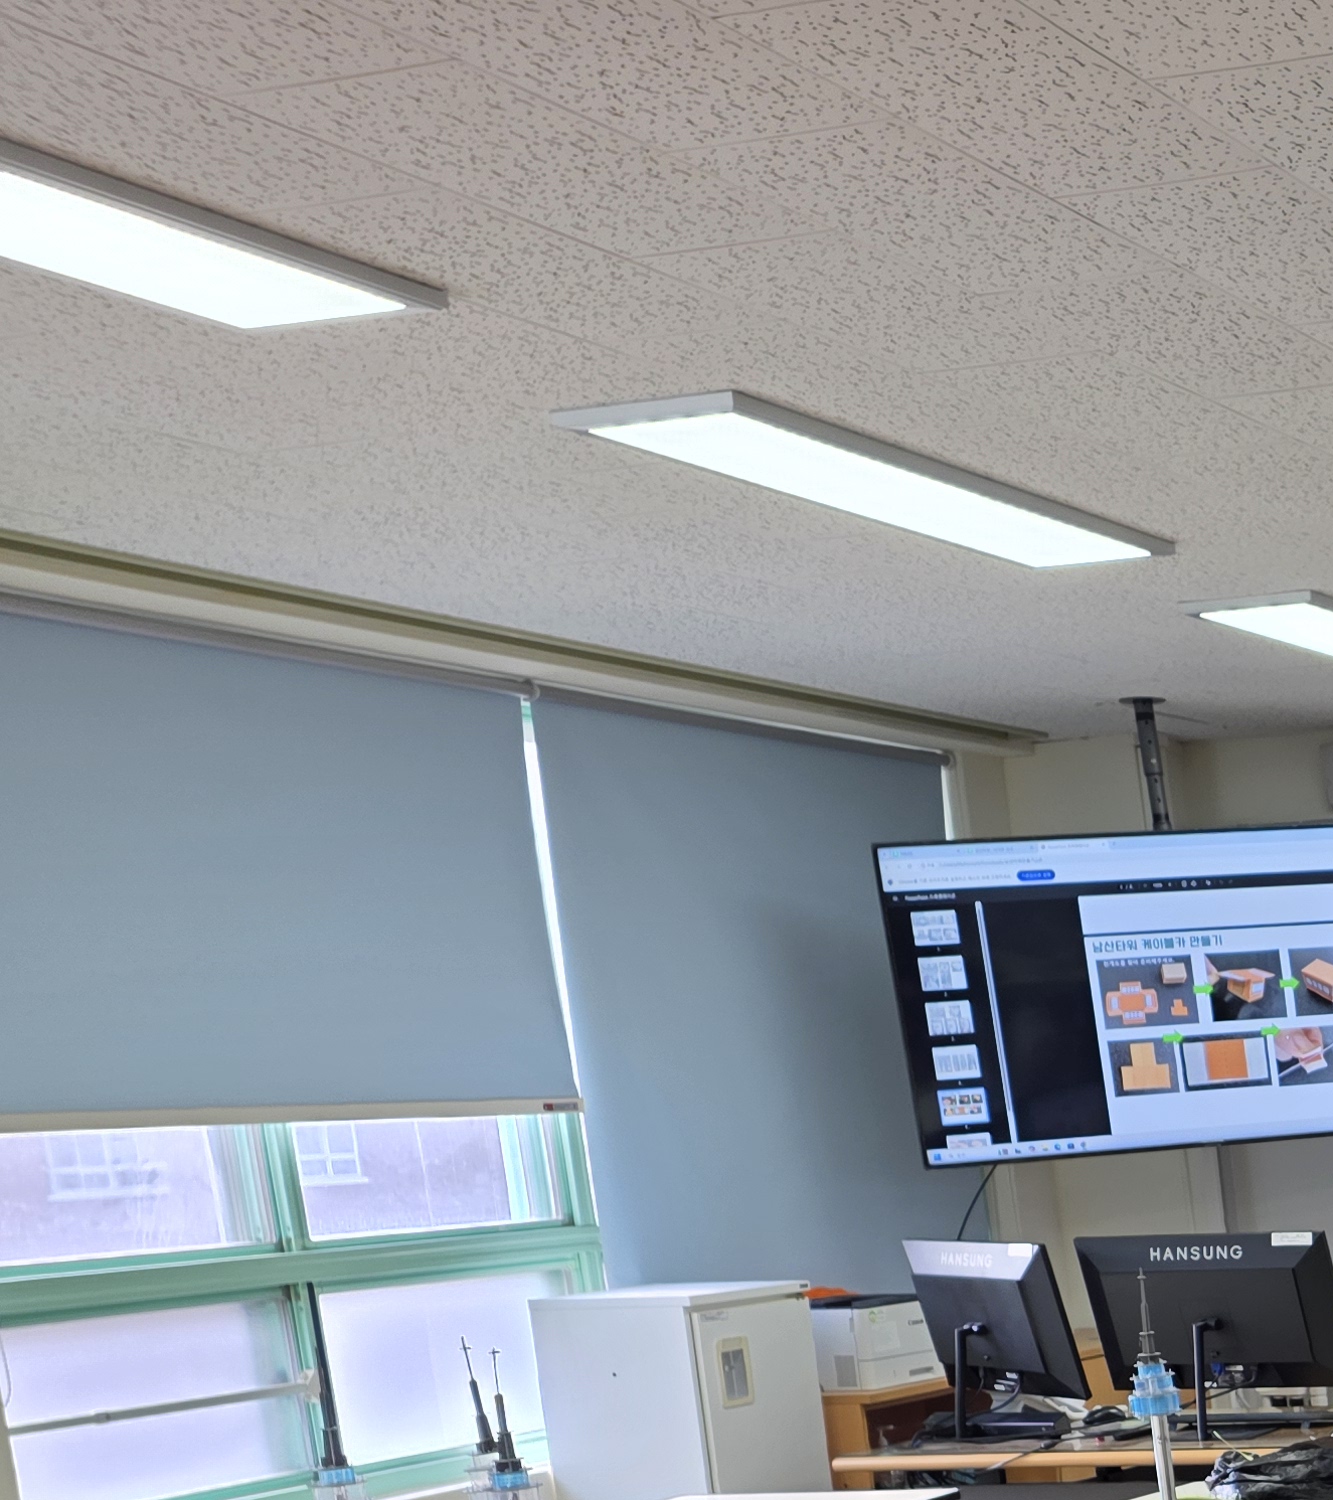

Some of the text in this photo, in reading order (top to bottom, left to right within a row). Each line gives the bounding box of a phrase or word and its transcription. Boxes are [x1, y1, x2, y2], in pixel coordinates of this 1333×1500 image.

[1092, 934, 1224, 953] 남산타워 케이블카 만들기
[940, 1250, 993, 1269] HANSUNG
[1149, 1244, 1244, 1263] HANSUNG
